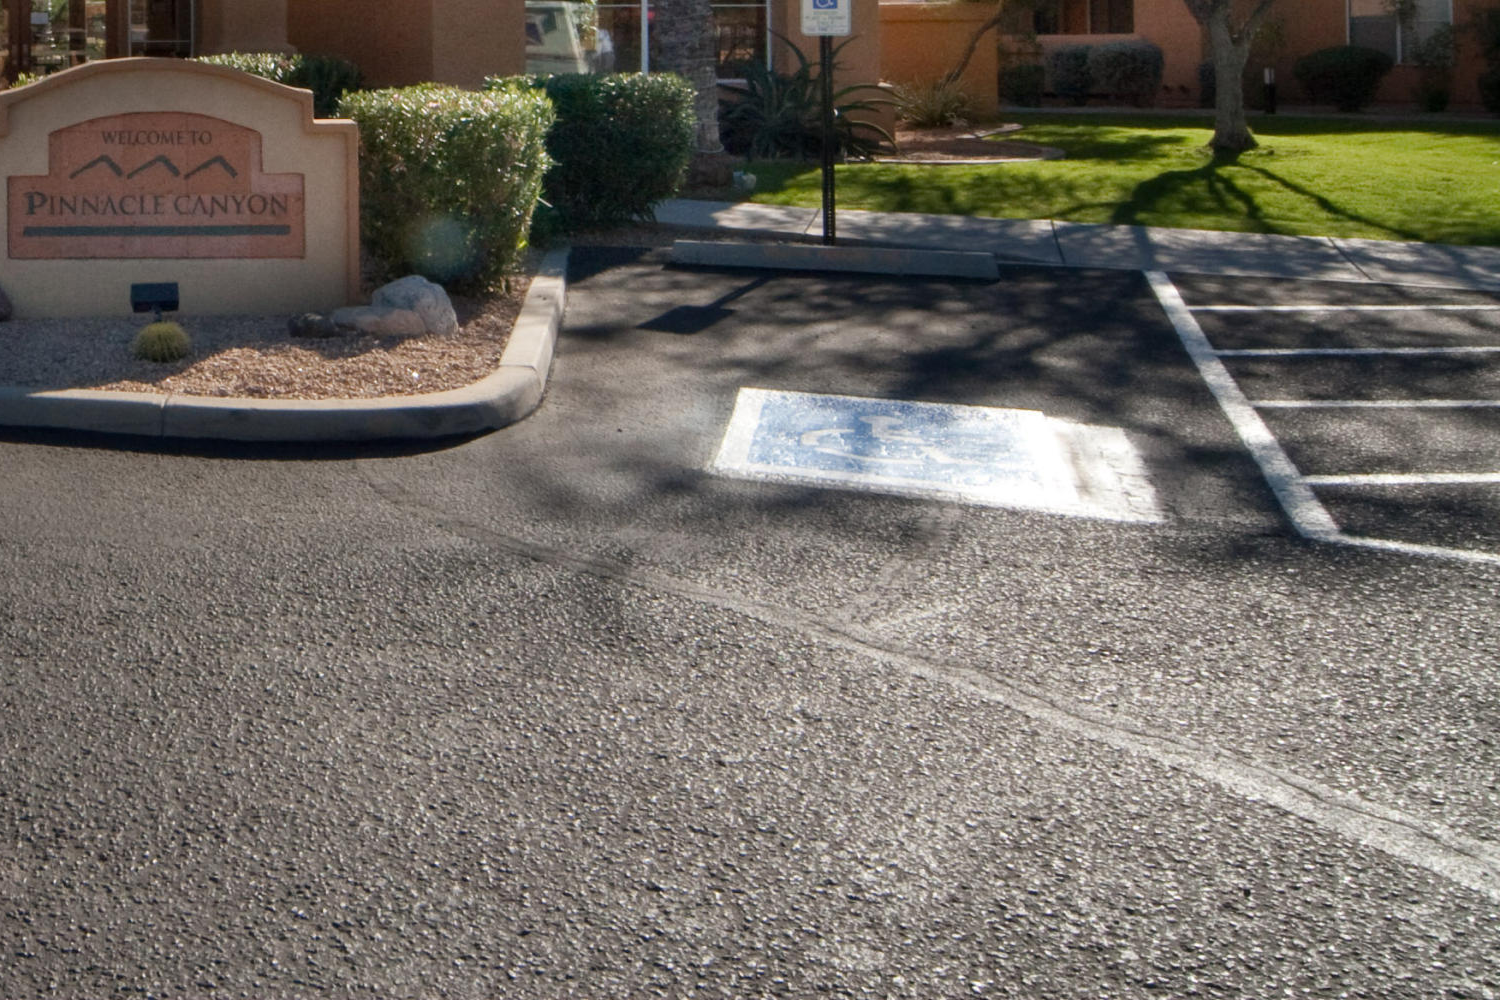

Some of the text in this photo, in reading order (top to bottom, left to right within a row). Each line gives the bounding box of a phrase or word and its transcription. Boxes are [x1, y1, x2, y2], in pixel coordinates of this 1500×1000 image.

[102, 130, 213, 145] WELCOME TO
[25, 191, 288, 218] PINNACLE CANYON
